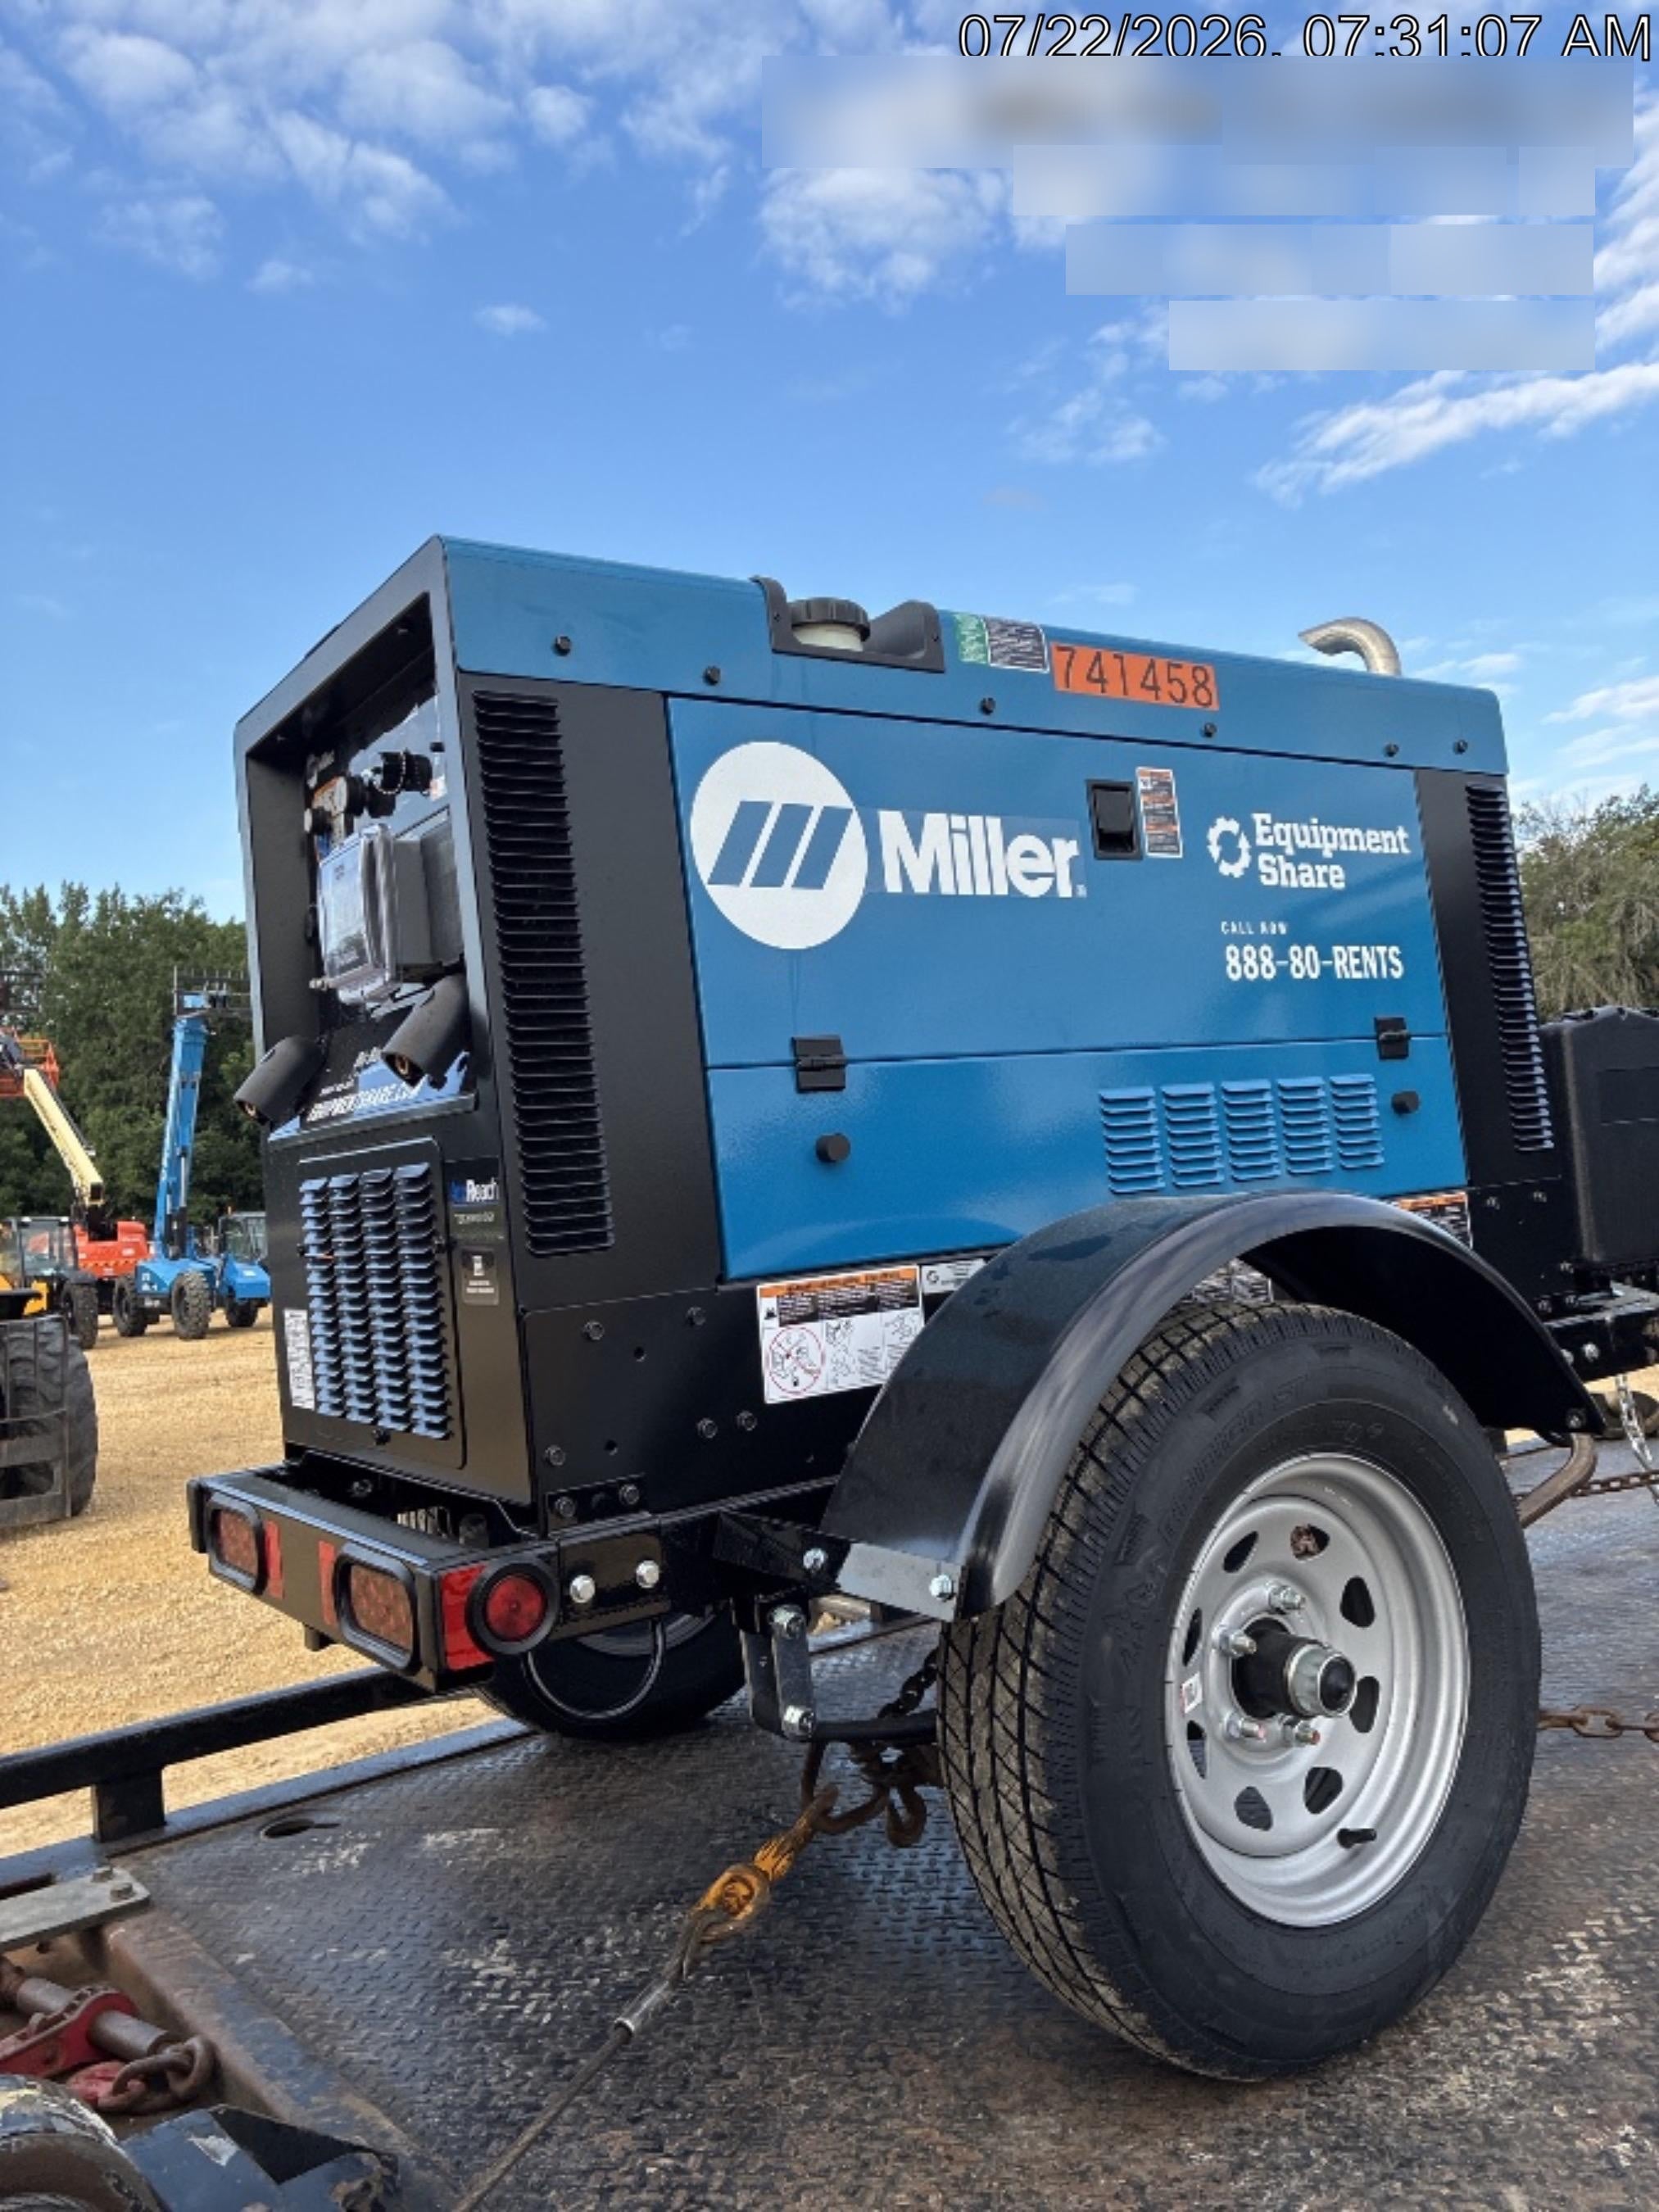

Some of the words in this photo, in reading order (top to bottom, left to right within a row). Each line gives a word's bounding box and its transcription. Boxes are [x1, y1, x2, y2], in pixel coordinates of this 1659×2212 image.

[1055, 646, 1214, 708] 741458
[877, 809, 1080, 898] Miller
[1252, 813, 1411, 857] Equipment
[1258, 854, 1346, 890] Share
[1225, 943, 1405, 981] 888-80-RENTS
